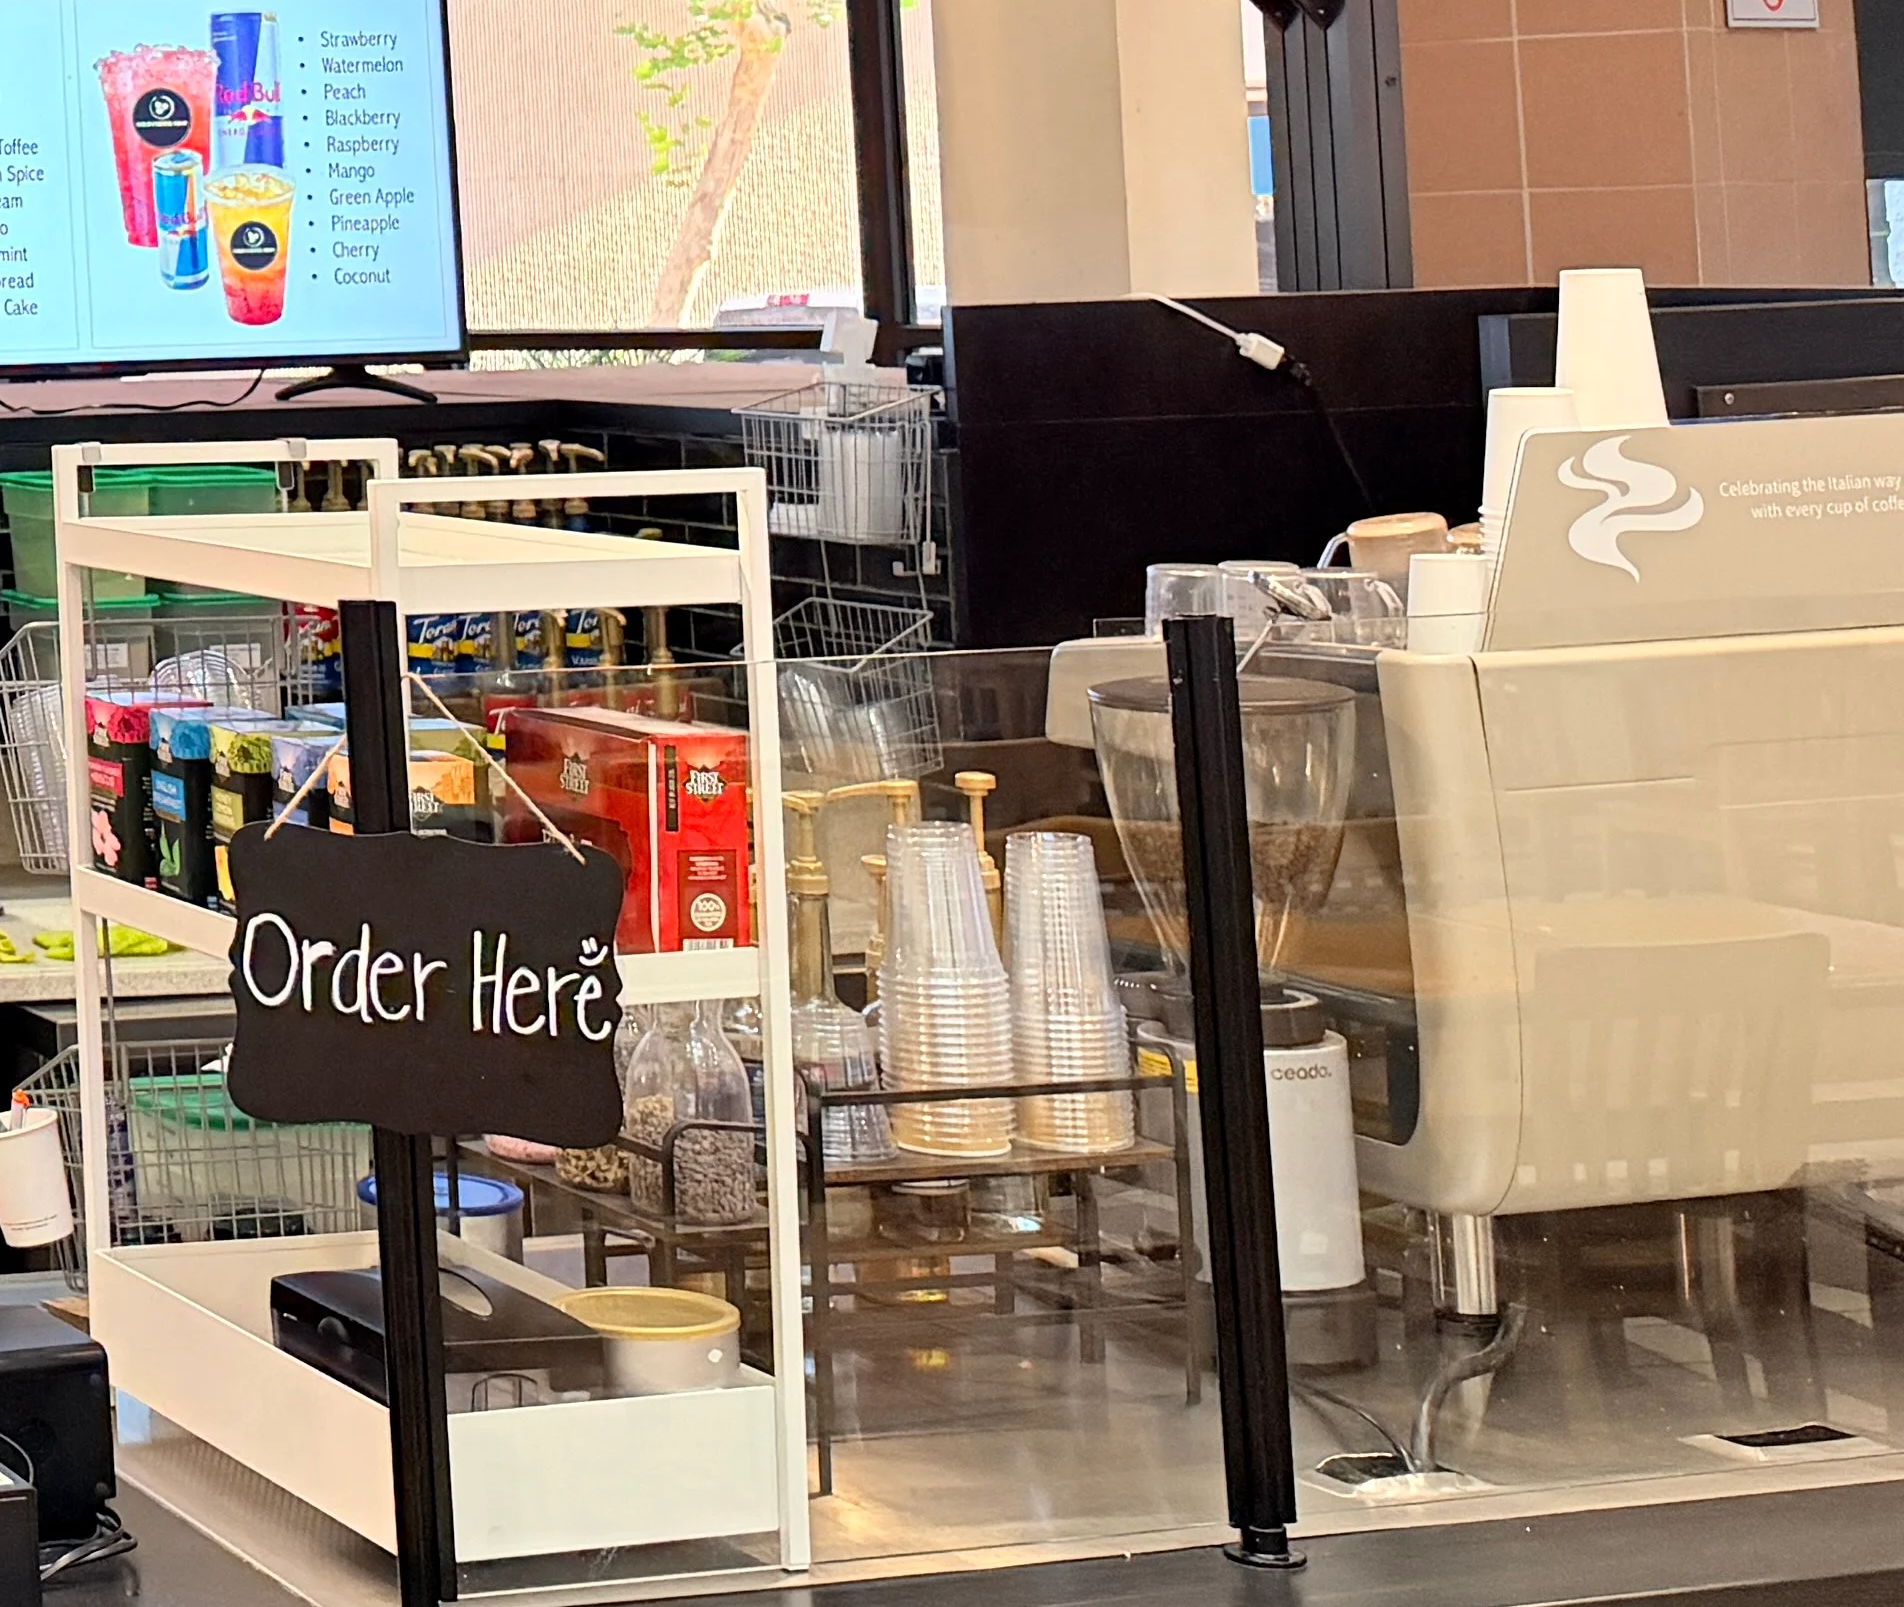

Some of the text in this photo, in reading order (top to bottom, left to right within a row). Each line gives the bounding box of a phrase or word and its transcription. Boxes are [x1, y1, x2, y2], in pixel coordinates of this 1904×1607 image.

[321, 31, 397, 49] Strawberry
[322, 57, 403, 74] Watermelon
[324, 83, 366, 100] Peach
[326, 109, 400, 128] Blackberry
[327, 136, 400, 155] Raspberry
[7, 167, 44, 185] Spice
[329, 163, 375, 182] Mango
[330, 189, 415, 207] Green Apple
[332, 215, 400, 234] Pineapple
[333, 241, 379, 261] Cherry
[334, 268, 391, 284] Coconut
[4, 300, 38, 316] Cake
[1719, 474, 1902, 498] Celebrating the Italian way
[1751, 502, 1783, 519] with
[1785, 503, 1823, 520] every
[1827, 501, 1853, 518] cup
[1855, 495, 1869, 513] of
[563, 758, 588, 779] FIRST
[690, 769, 719, 784] FIRST
[560, 773, 590, 794] STREET
[685, 781, 724, 795] STREET
[242, 912, 612, 1041] Order Here
